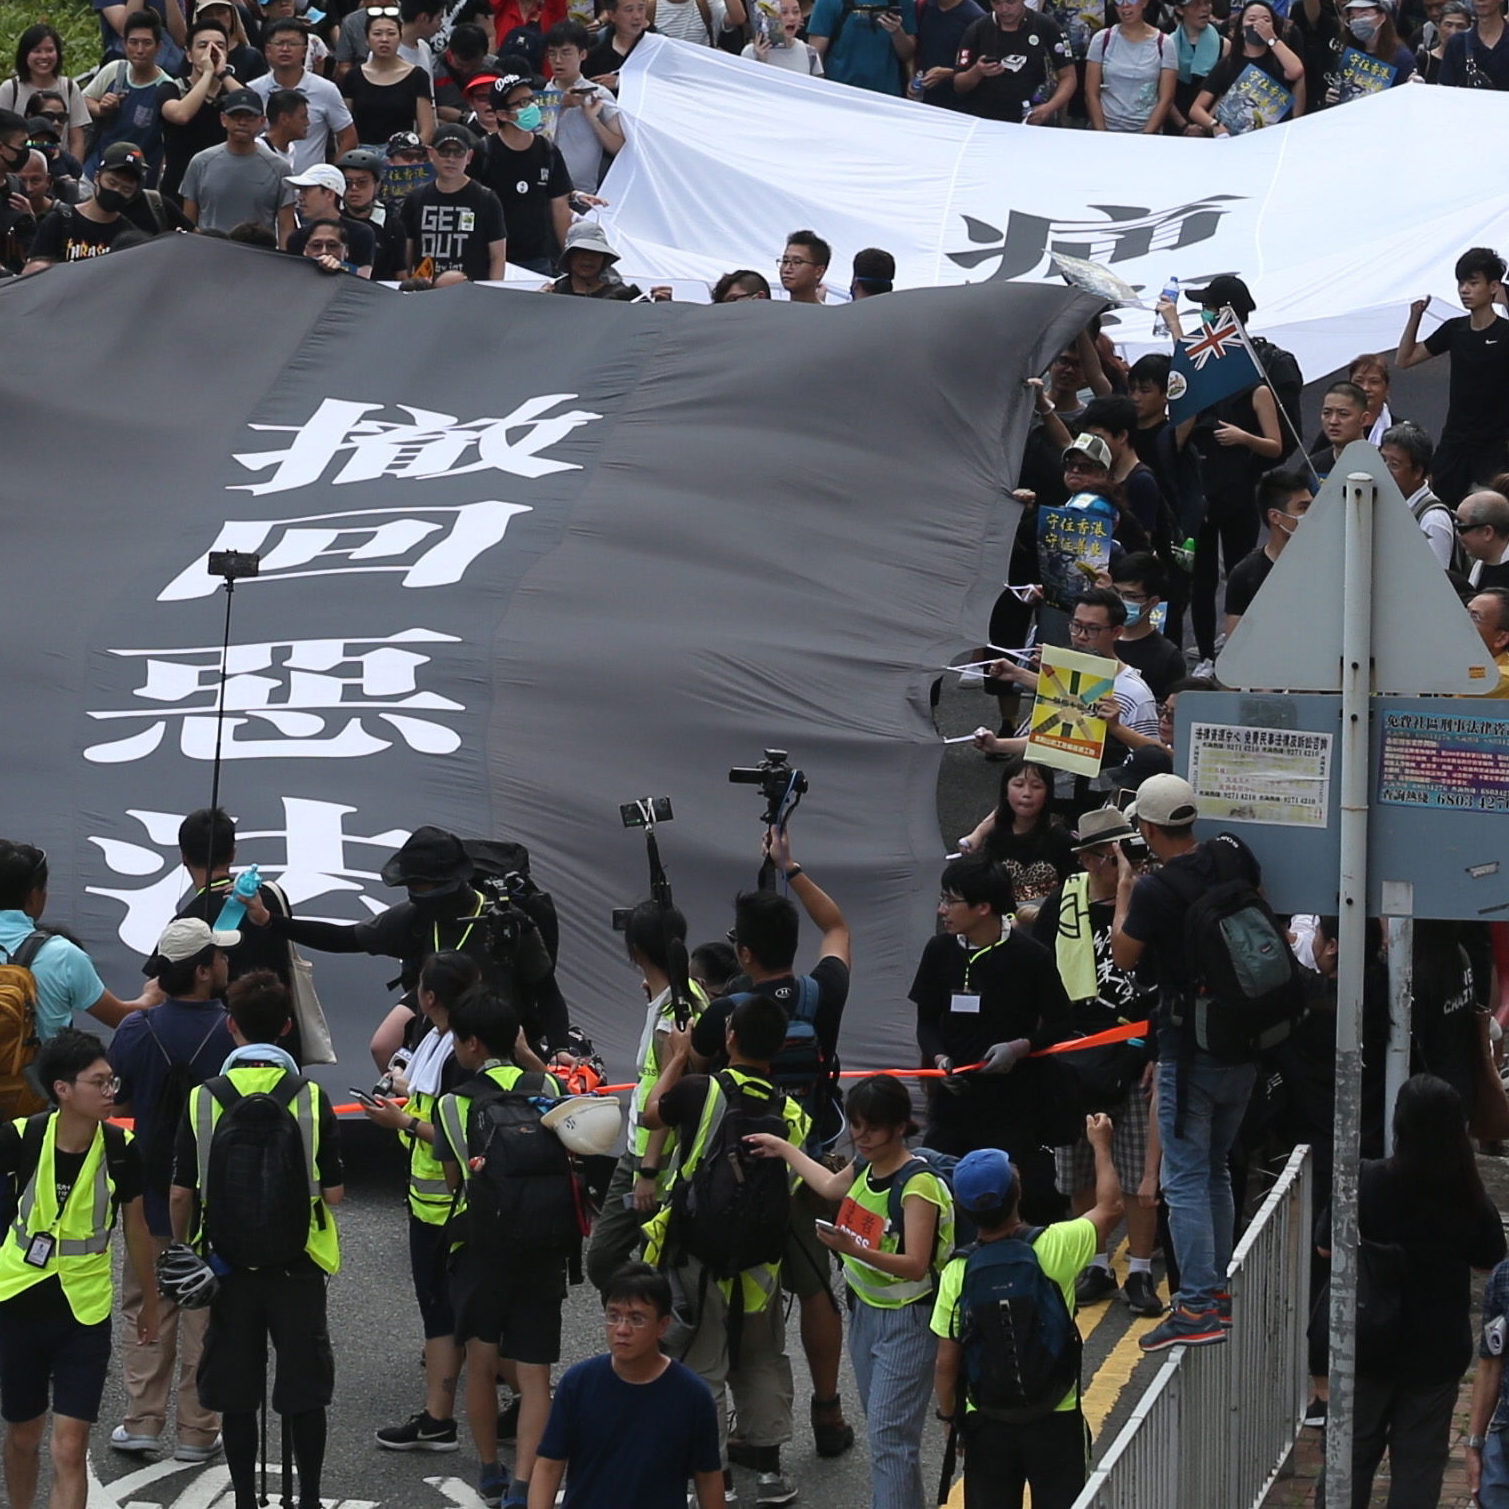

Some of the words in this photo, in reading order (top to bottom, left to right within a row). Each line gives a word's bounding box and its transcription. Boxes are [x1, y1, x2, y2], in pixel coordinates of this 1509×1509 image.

[422, 206, 469, 231] GET
[422, 234, 468, 258] OUT
[1045, 512, 1108, 538] 守住香港
[82, 392, 603, 955] 撤回惡法
[1436, 794, 1473, 808] 6803
